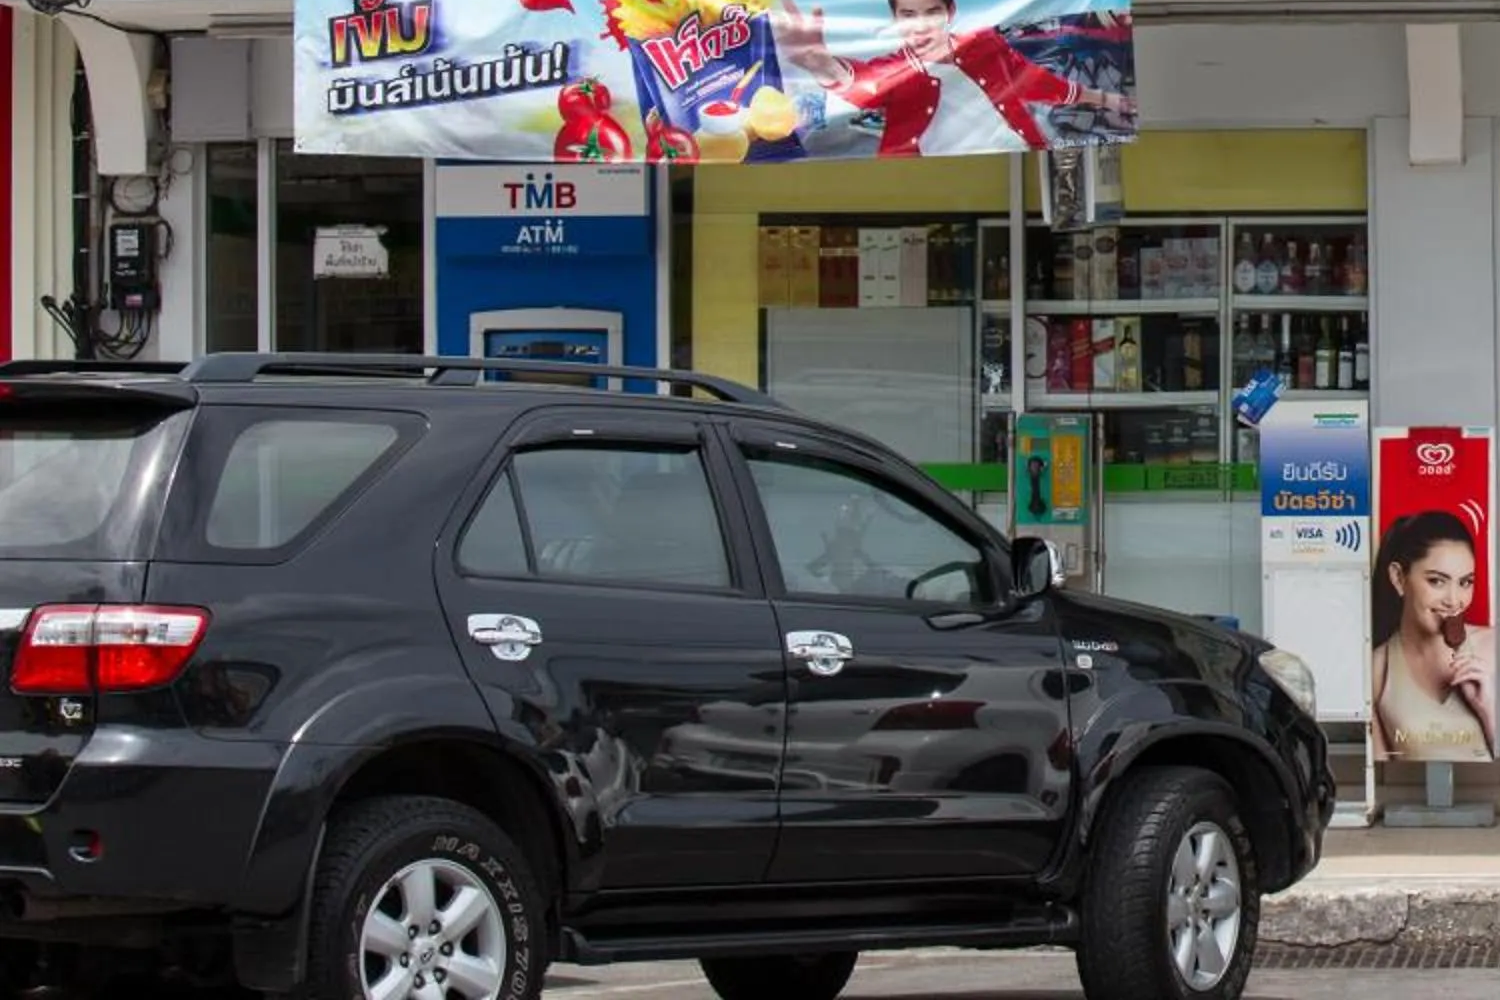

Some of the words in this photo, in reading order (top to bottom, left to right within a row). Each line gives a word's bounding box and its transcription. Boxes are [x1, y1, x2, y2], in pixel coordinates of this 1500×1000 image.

[328, 42, 568, 113] มันส์เน้นเน้น!
[503, 173, 577, 209] TMB
[516, 219, 565, 244] ATM
[1283, 460, 1348, 482] ยินดีรับ
[1274, 489, 1356, 511] บัตรวีซ่า
[1296, 528, 1324, 539] VISA
